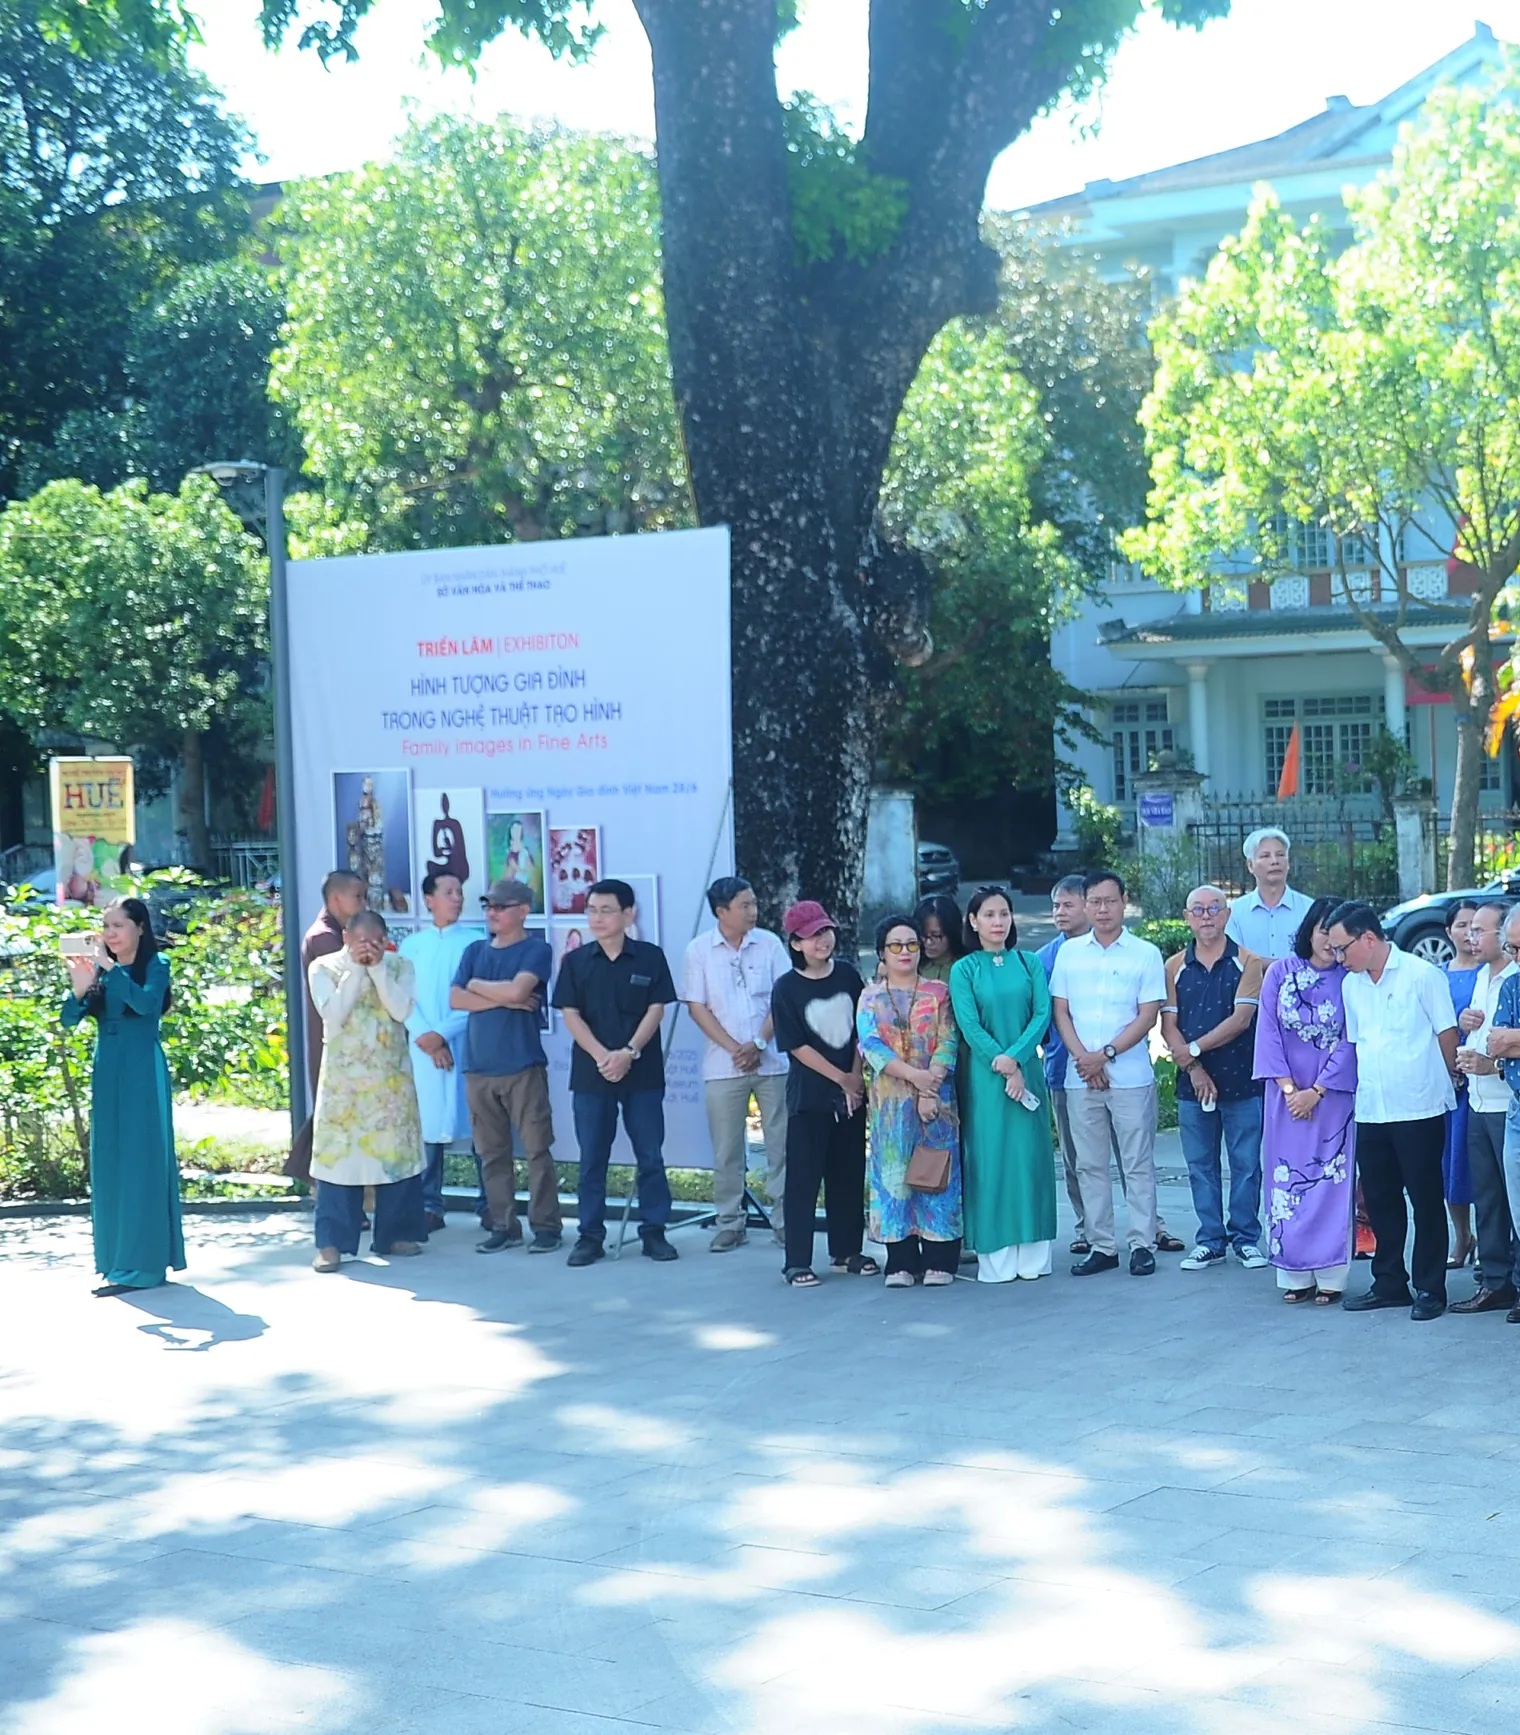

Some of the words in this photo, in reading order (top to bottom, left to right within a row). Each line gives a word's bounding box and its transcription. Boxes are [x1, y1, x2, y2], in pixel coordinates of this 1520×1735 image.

[504, 632, 578, 653] EXHIBITON
[410, 672, 447, 697] HÌNH
[513, 671, 543, 692] GIA
[546, 664, 586, 690] ĐÌNH
[381, 709, 437, 731] TRONG
[490, 700, 539, 729] THUẬT
[544, 703, 578, 728] TẠO
[582, 696, 622, 723] HÌNH
[402, 738, 450, 759] Family
[456, 737, 514, 758] images
[538, 733, 571, 751] Fine
[577, 731, 608, 750] Arts
